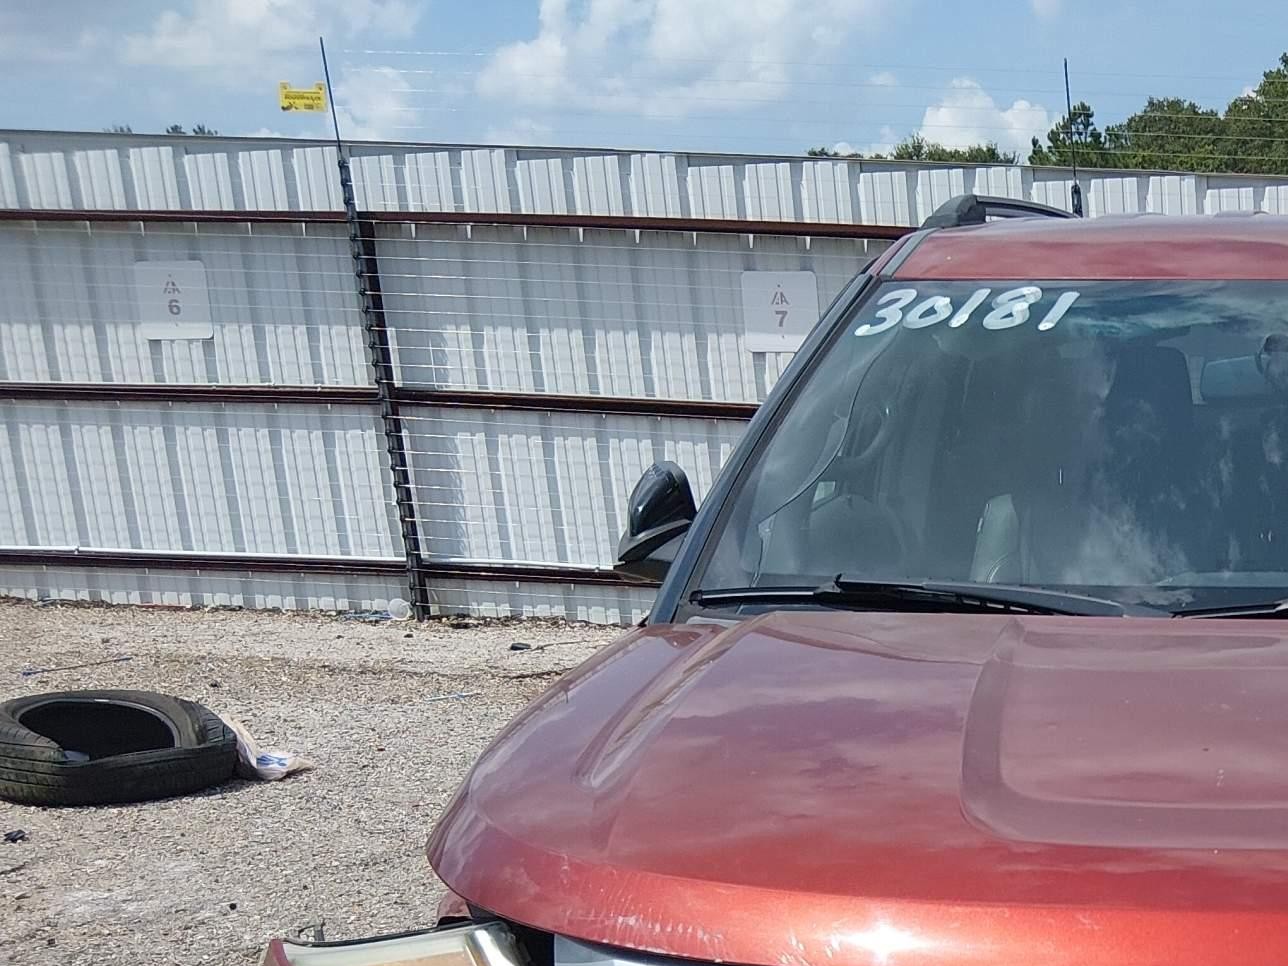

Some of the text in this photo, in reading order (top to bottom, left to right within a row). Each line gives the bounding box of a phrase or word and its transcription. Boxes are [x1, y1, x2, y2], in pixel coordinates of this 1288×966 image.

[168, 299, 181, 316] 6
[854, 286, 1081, 337] 30181
[774, 310, 788, 328] 7
